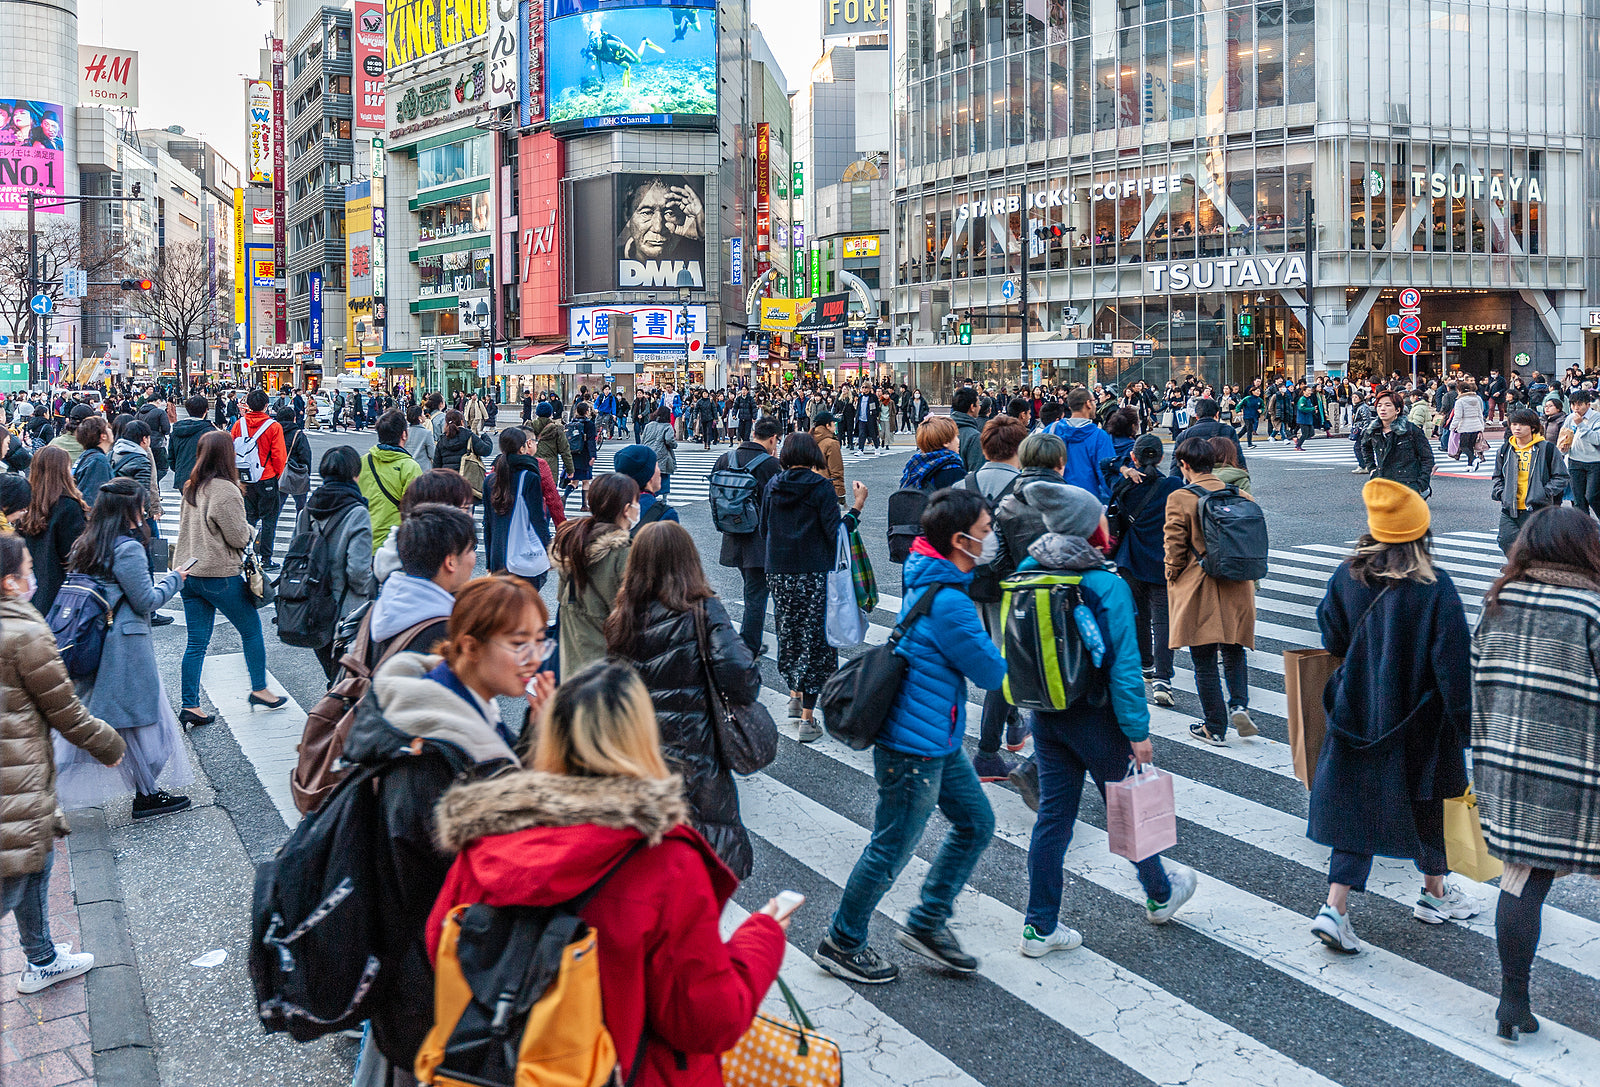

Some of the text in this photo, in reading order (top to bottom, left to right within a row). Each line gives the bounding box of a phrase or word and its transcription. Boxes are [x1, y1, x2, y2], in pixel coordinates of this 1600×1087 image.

[386, 0, 488, 69] KING GNU
[85, 54, 131, 85] H&M
[603, 116, 651, 125] DHC Channel
[0, 157, 55, 189] No.1
[1090, 174, 1183, 201] COFFEE
[1412, 172, 1543, 202] TSUTAYA
[422, 222, 470, 240] Euphoria
[523, 209, 557, 283] クスリ
[351, 245, 370, 277] 薬
[1147, 256, 1307, 291] TSUTAYA
[577, 312, 697, 337] 大盛書店
